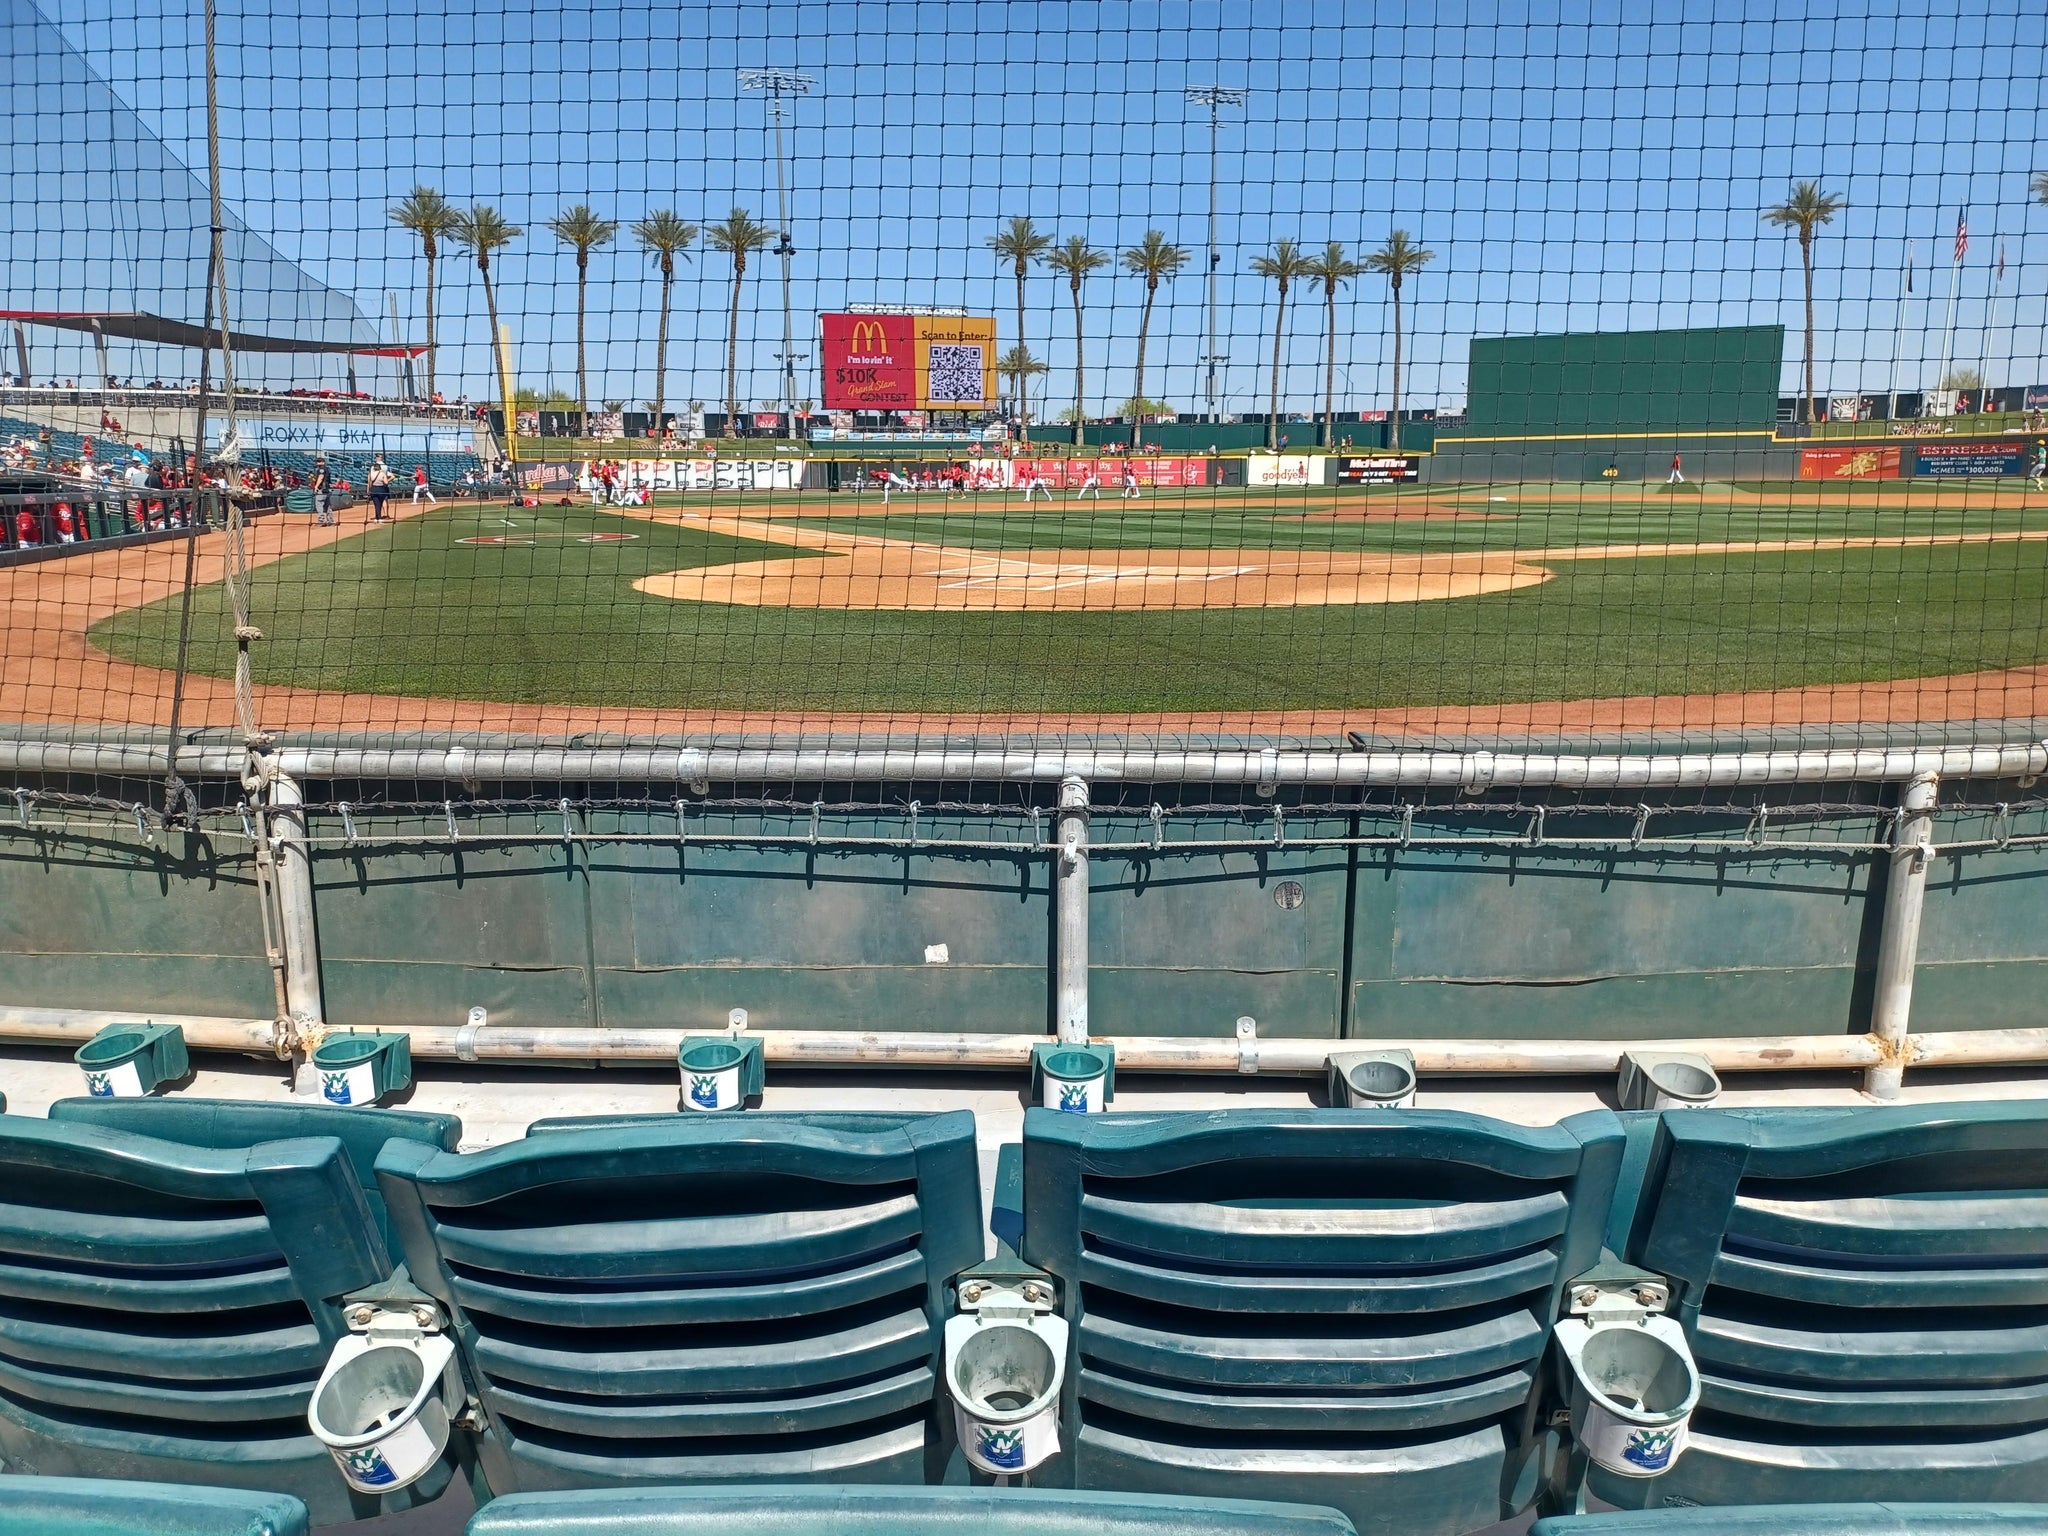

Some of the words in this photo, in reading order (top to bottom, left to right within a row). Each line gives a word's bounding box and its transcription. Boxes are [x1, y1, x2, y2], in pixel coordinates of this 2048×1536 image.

[921, 330, 945, 341] Scan
[947, 332, 957, 340] to
[836, 368, 877, 384] $10K
[847, 382, 874, 397] Grand
[874, 380, 897, 392] Slam
[859, 392, 908, 402] CONTEST
[264, 426, 310, 443] ROXX
[1262, 469, 1309, 481] goodyer
[1602, 469, 1618, 477] 410
